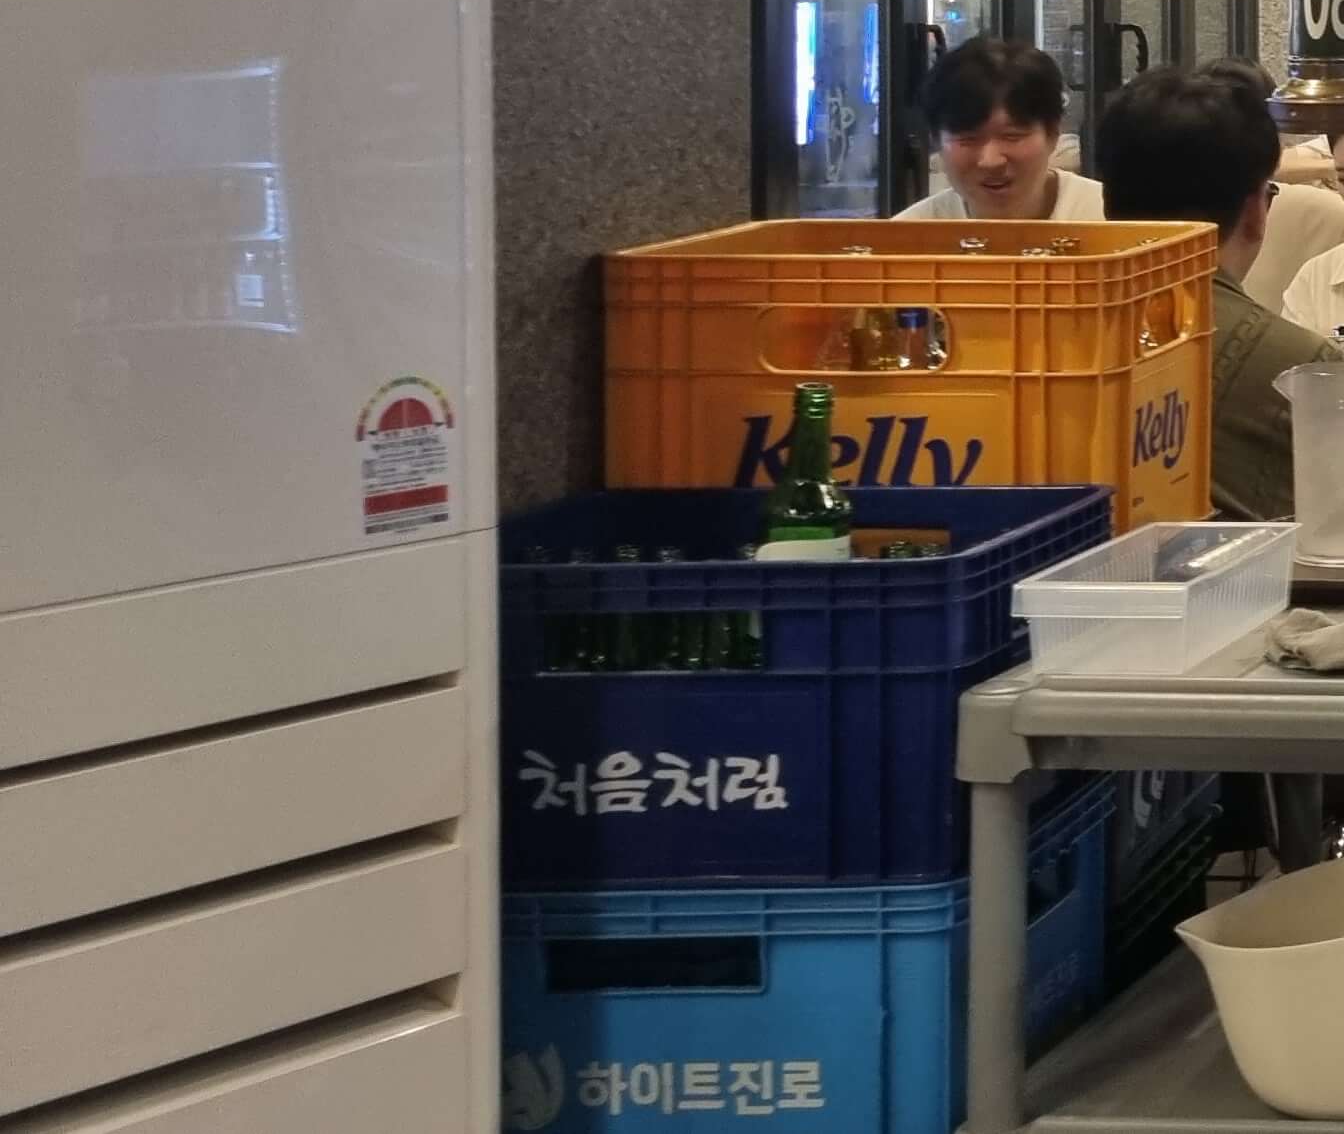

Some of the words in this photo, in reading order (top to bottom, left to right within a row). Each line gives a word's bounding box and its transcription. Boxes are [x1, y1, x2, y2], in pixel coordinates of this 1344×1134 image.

[1132, 388, 1189, 469] Kelly
[519, 751, 788, 816] 처음처럼
[577, 1060, 825, 1116] 하이트진로
